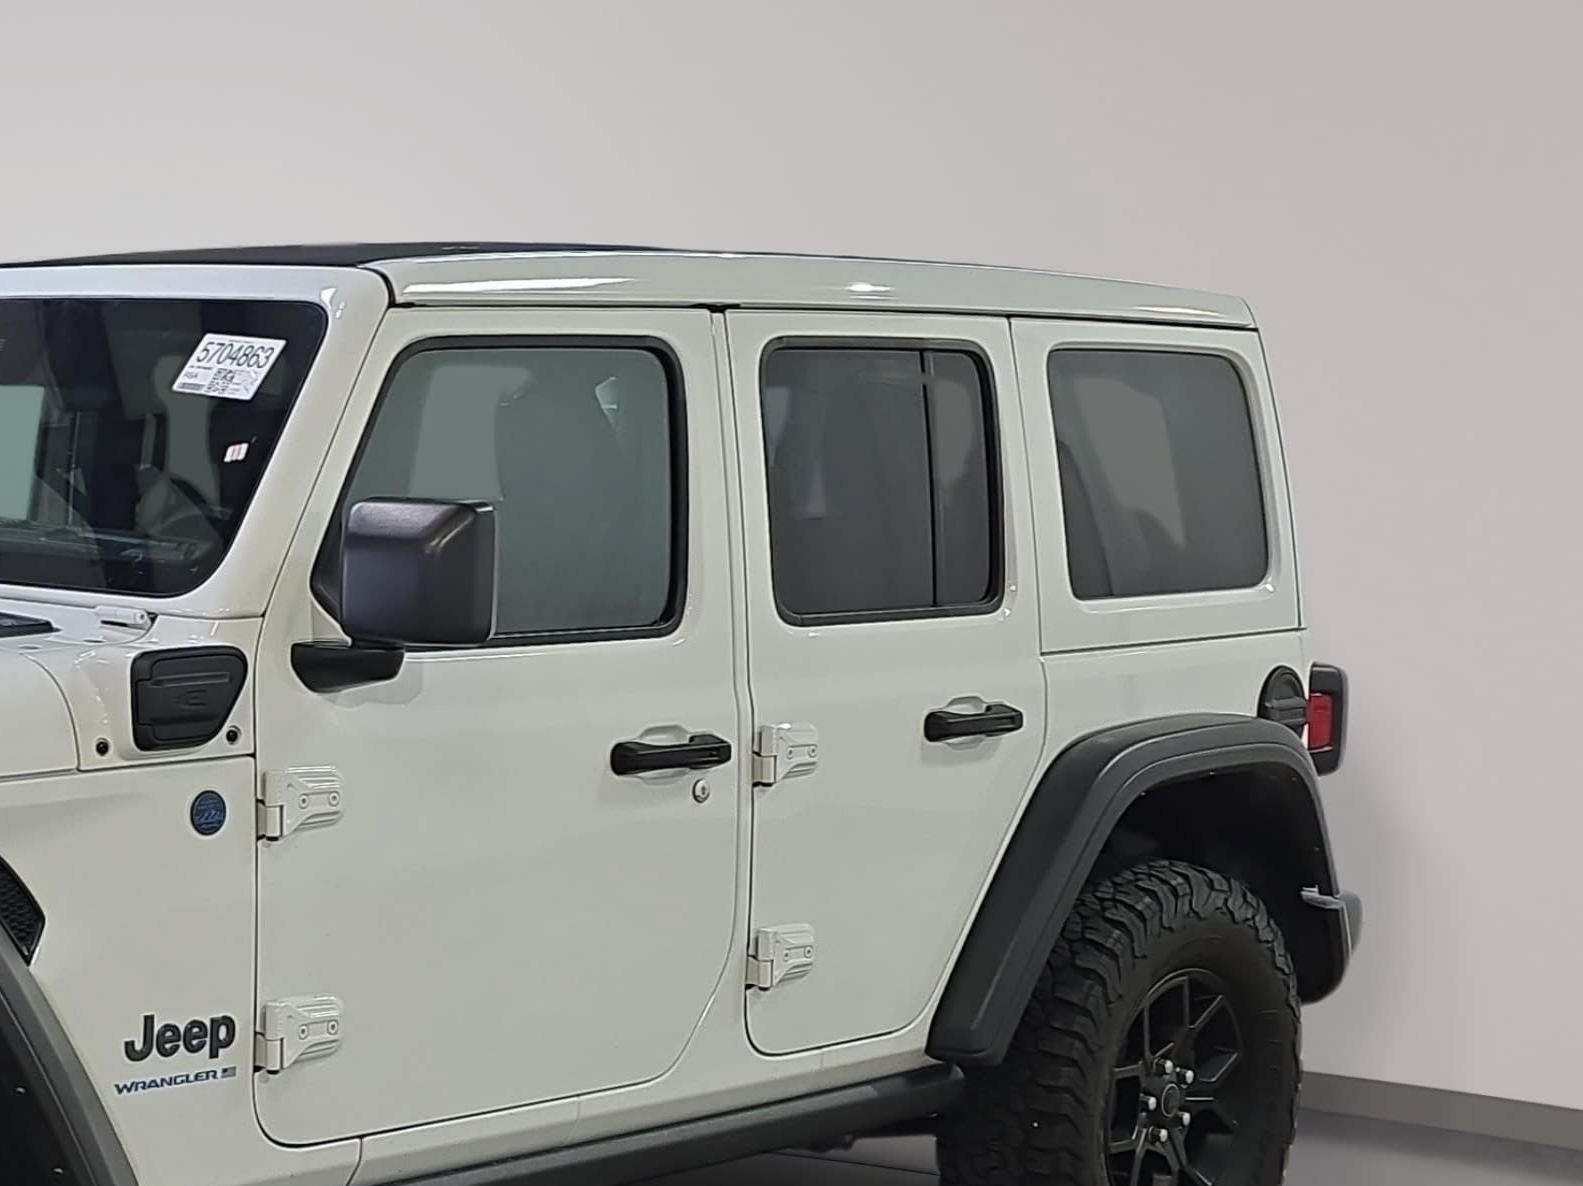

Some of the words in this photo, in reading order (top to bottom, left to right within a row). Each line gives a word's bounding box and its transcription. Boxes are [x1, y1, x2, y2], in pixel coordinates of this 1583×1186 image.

[196, 341, 275, 369] 5704863
[124, 1014, 236, 1062] Jeep
[114, 1069, 218, 1095] WRANGLER
